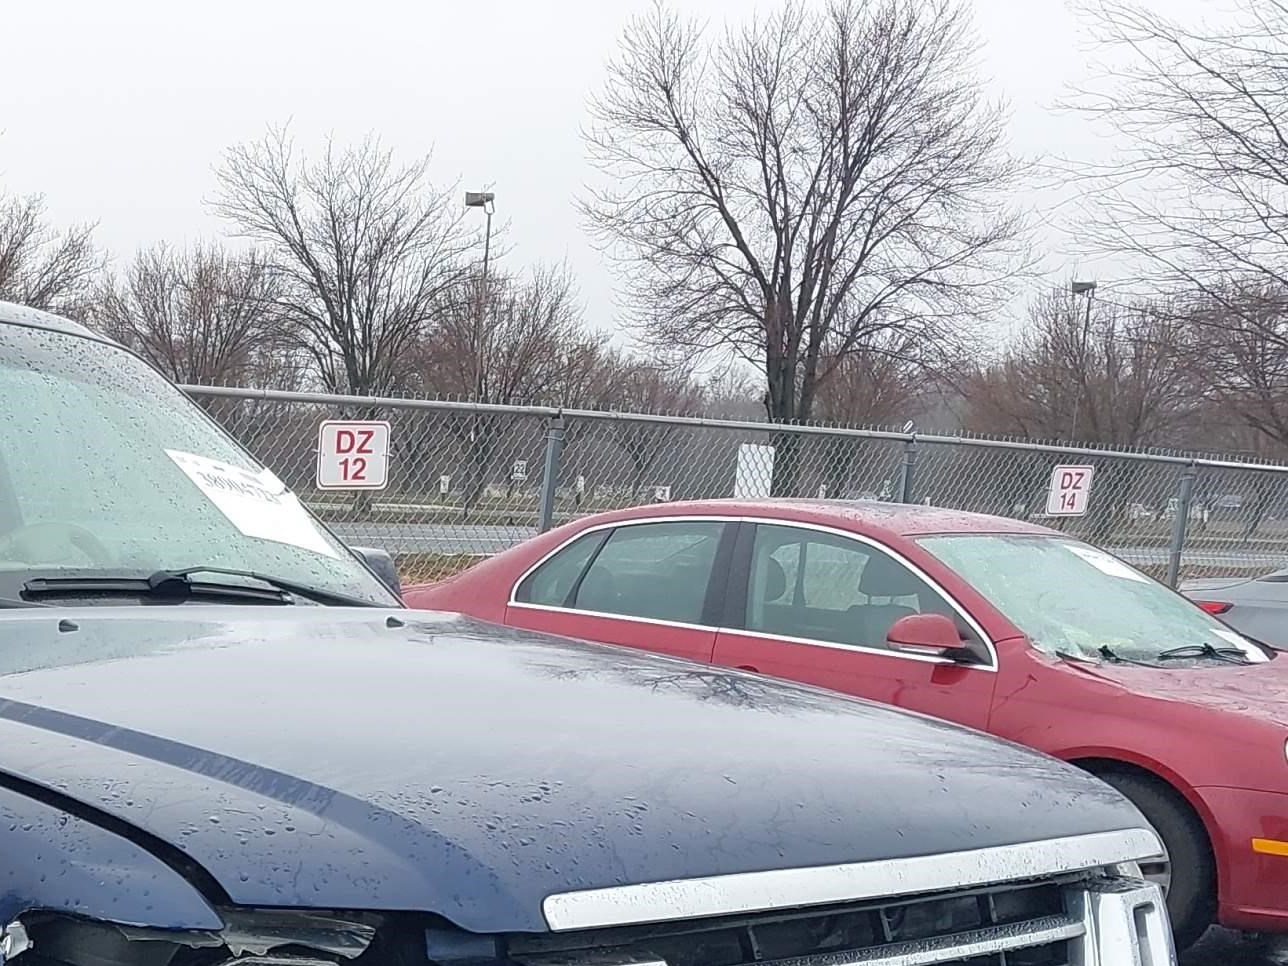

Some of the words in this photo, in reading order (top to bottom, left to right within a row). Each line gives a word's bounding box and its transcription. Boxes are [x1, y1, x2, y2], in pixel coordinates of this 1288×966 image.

[335, 430, 375, 454] DZ
[338, 457, 367, 481] 12
[1060, 472, 1085, 490] DZ
[1059, 492, 1076, 511] 14
